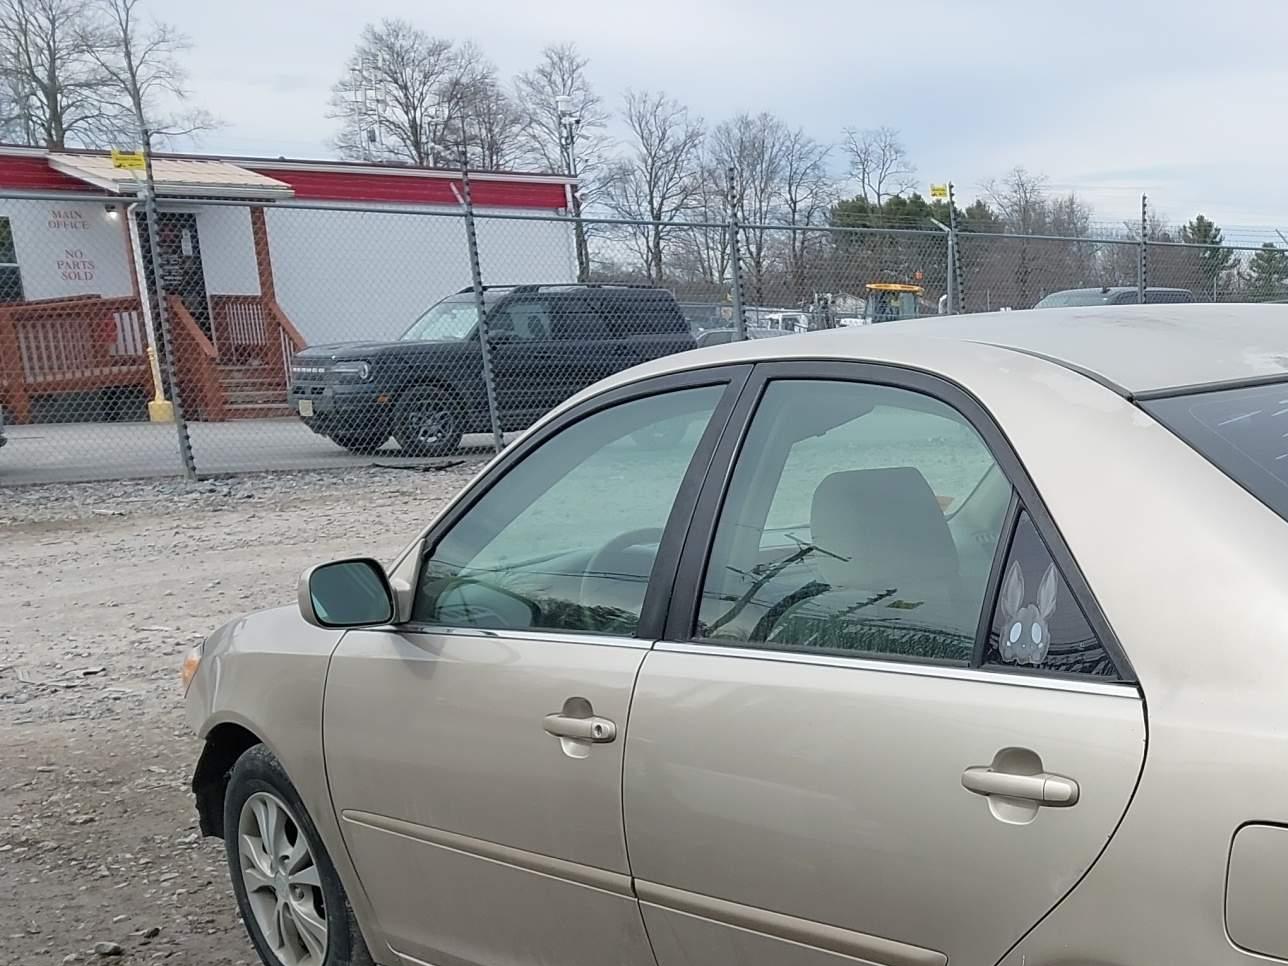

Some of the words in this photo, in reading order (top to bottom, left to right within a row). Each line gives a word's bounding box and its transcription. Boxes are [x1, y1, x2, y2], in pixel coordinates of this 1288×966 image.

[49, 209, 83, 219] MAIN
[47, 220, 89, 230] OFFICE
[64, 248, 84, 259] NO
[56, 260, 96, 270] PARTS
[61, 271, 94, 281] SOLD
